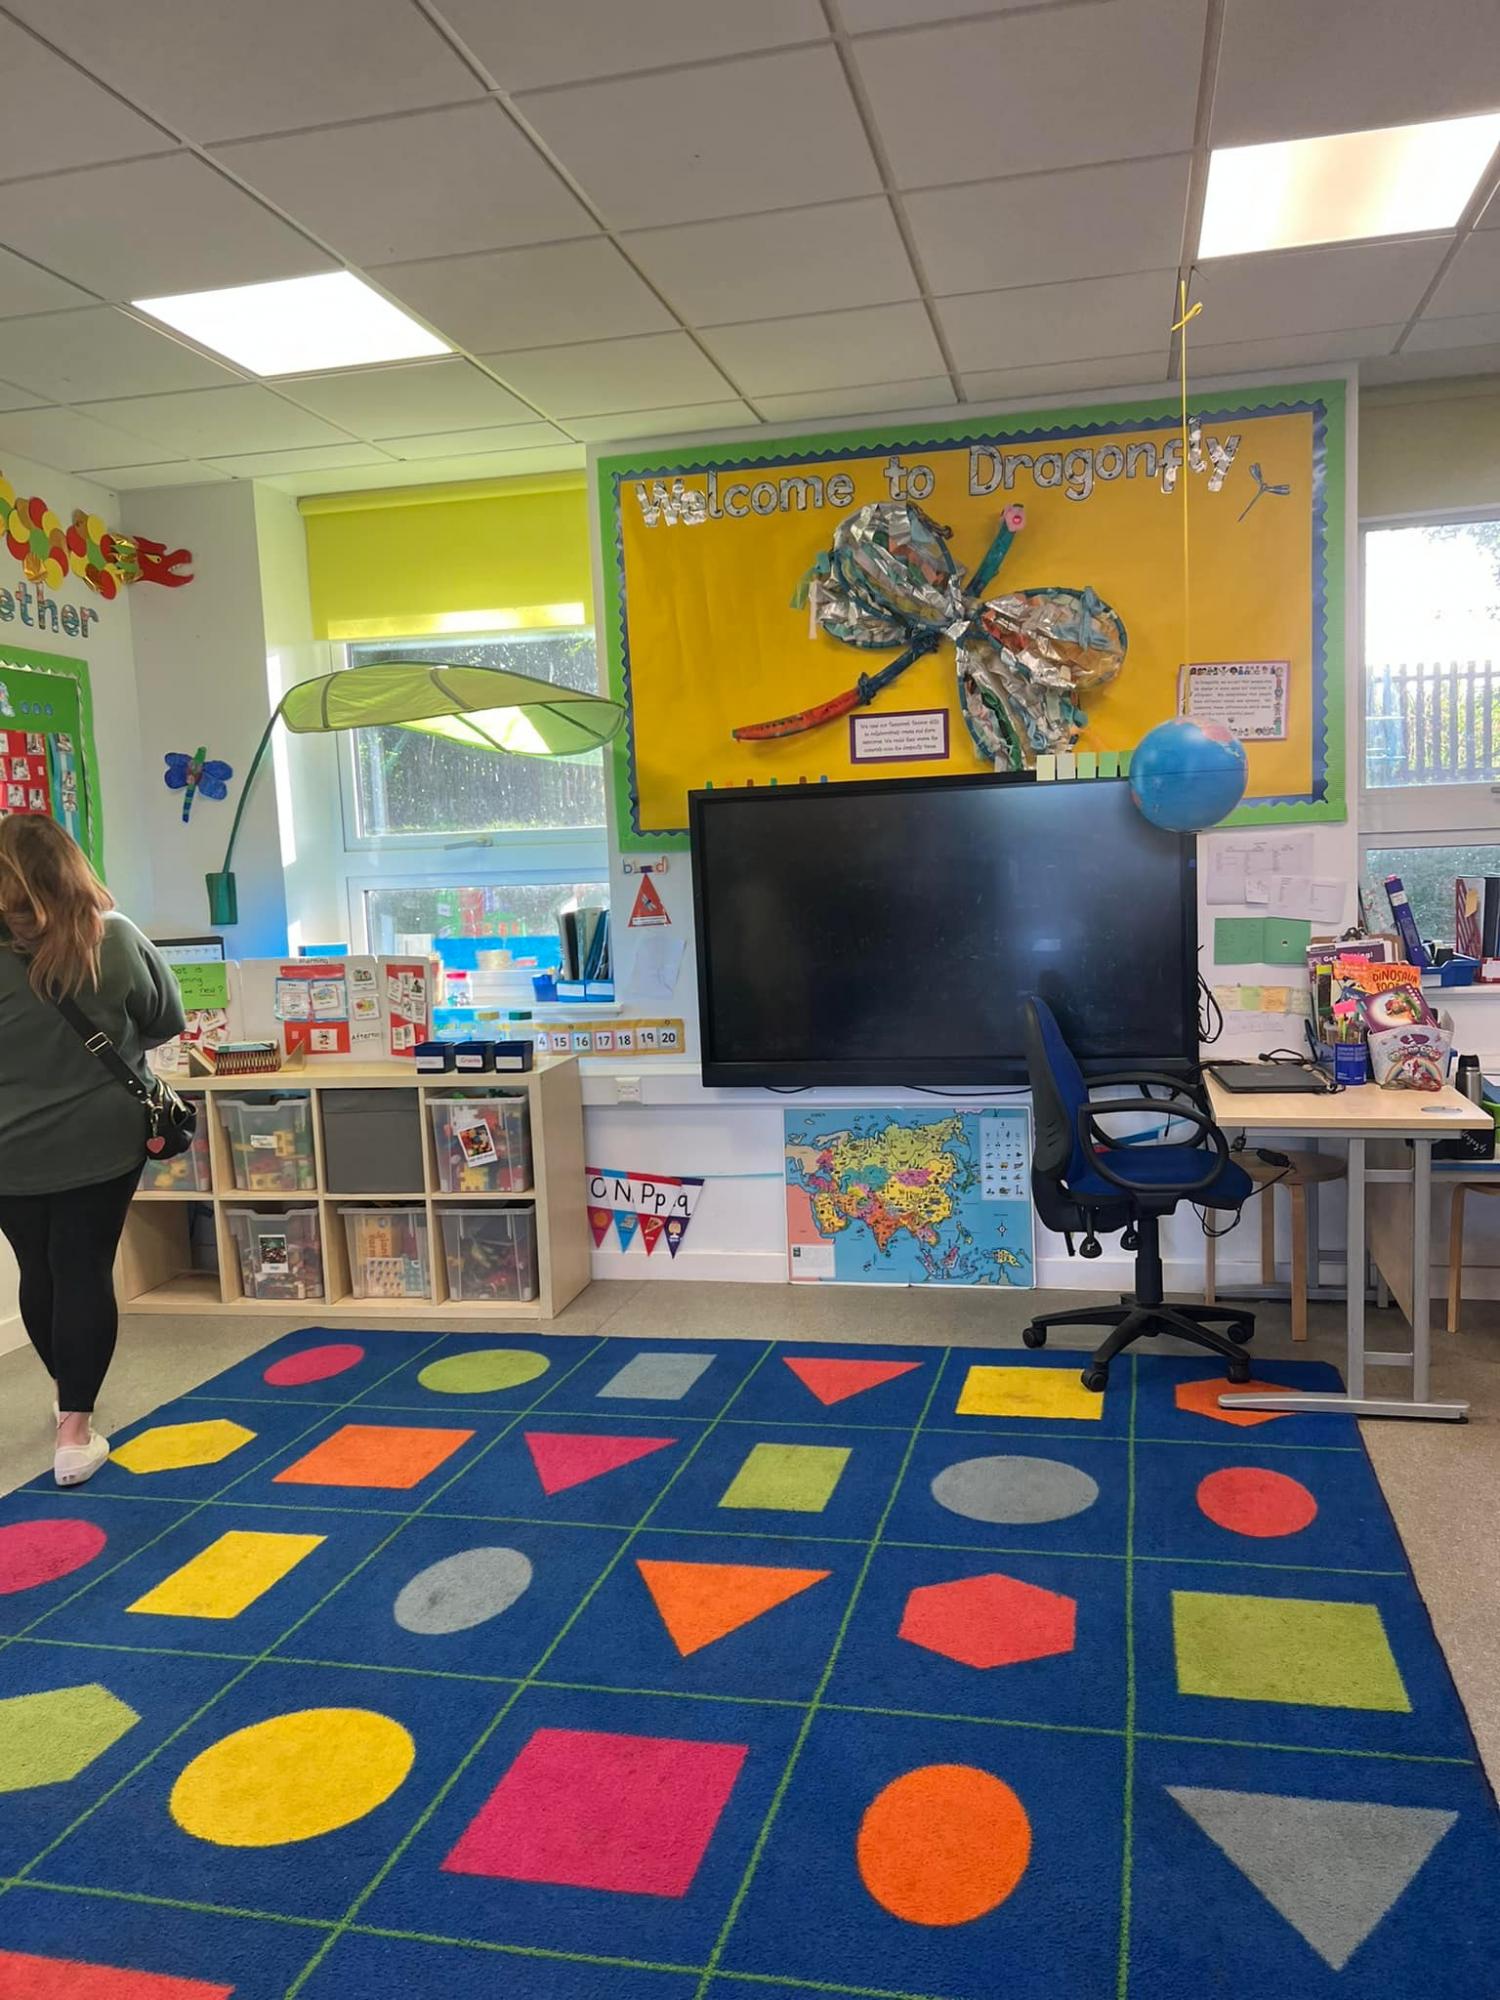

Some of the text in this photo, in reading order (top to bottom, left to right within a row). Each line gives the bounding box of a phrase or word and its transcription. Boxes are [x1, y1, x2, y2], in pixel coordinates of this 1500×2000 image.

[634, 416, 1242, 528] Welcome to Dragonfly
[553, 1036, 567, 1048] 15
[575, 1036, 589, 1047] 16
[597, 1035, 611, 1047] 17
[618, 1034, 631, 1046] 18
[640, 1032, 654, 1044] 19
[661, 1032, 676, 1044] 20
